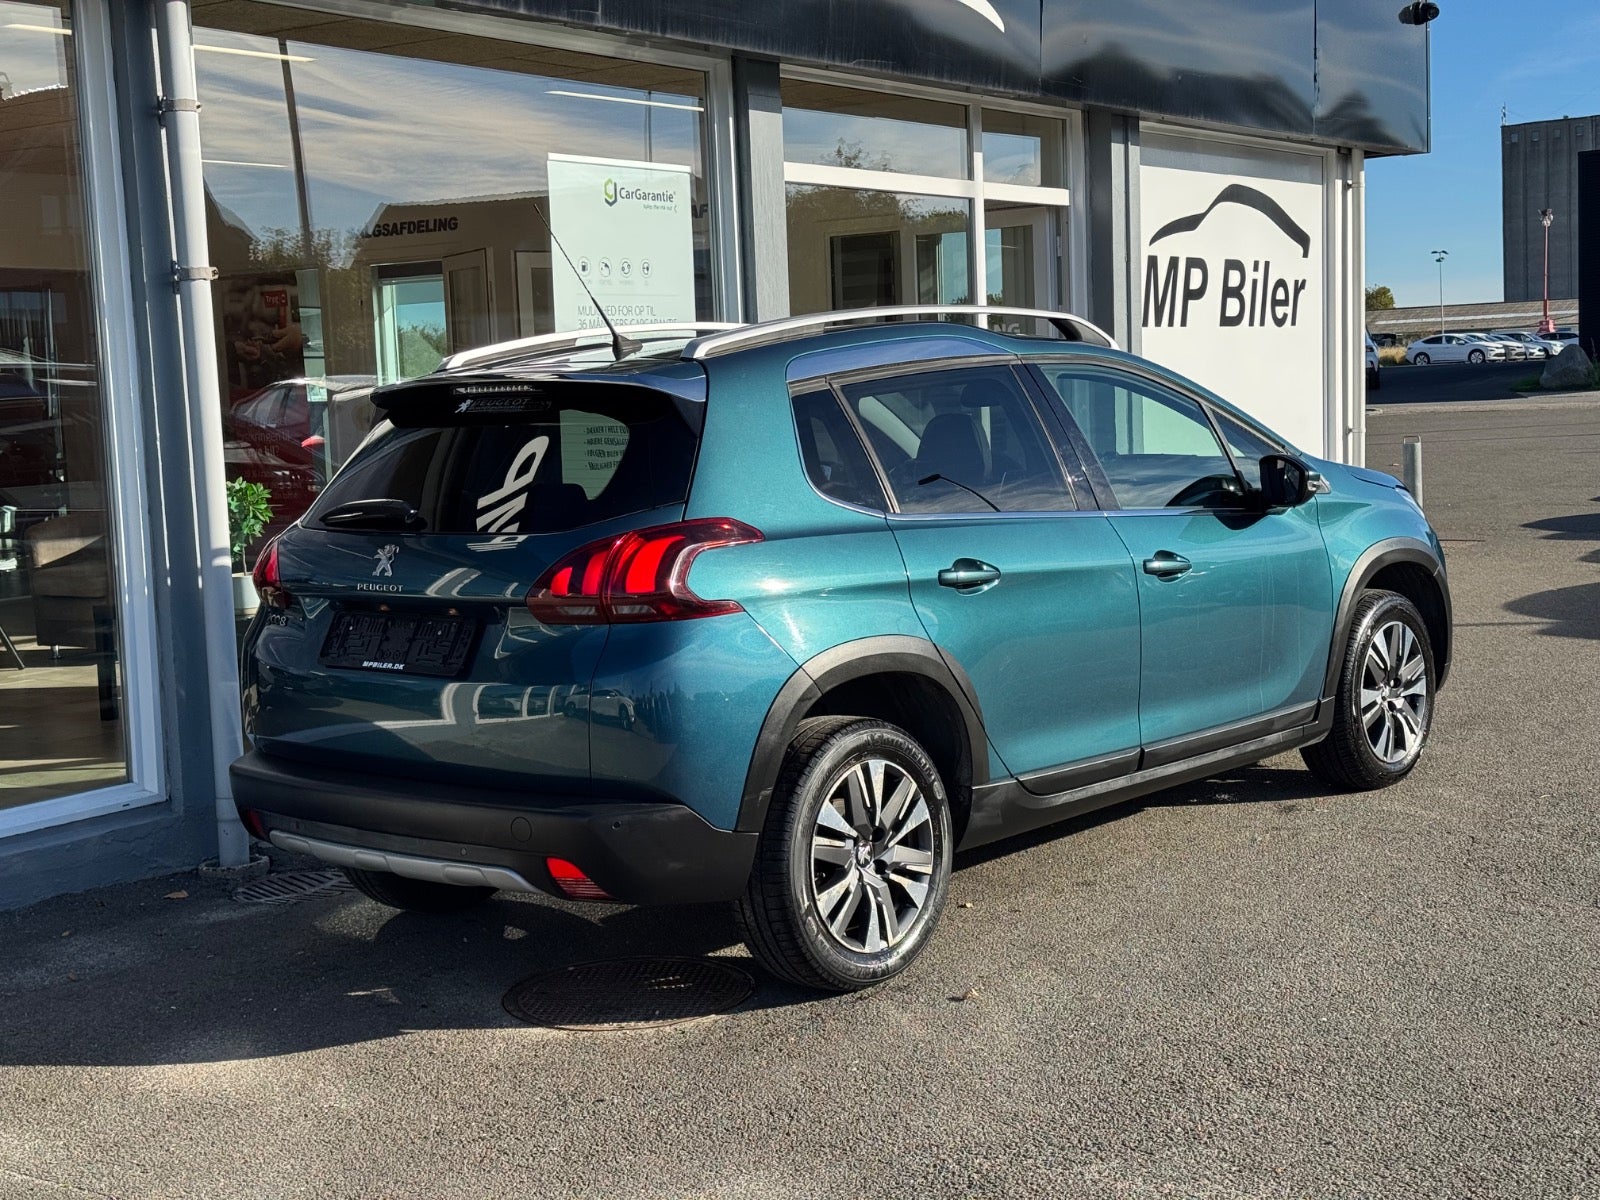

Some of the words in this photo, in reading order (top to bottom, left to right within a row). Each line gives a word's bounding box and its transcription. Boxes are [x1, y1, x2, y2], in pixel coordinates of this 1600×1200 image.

[1142, 254, 1209, 327] MP
[1219, 258, 1307, 327] Biler
[618, 305, 633, 317] FOR
[634, 305, 645, 316] OP
[578, 319, 588, 330] 36
[357, 583, 404, 592] PEUGEOT
